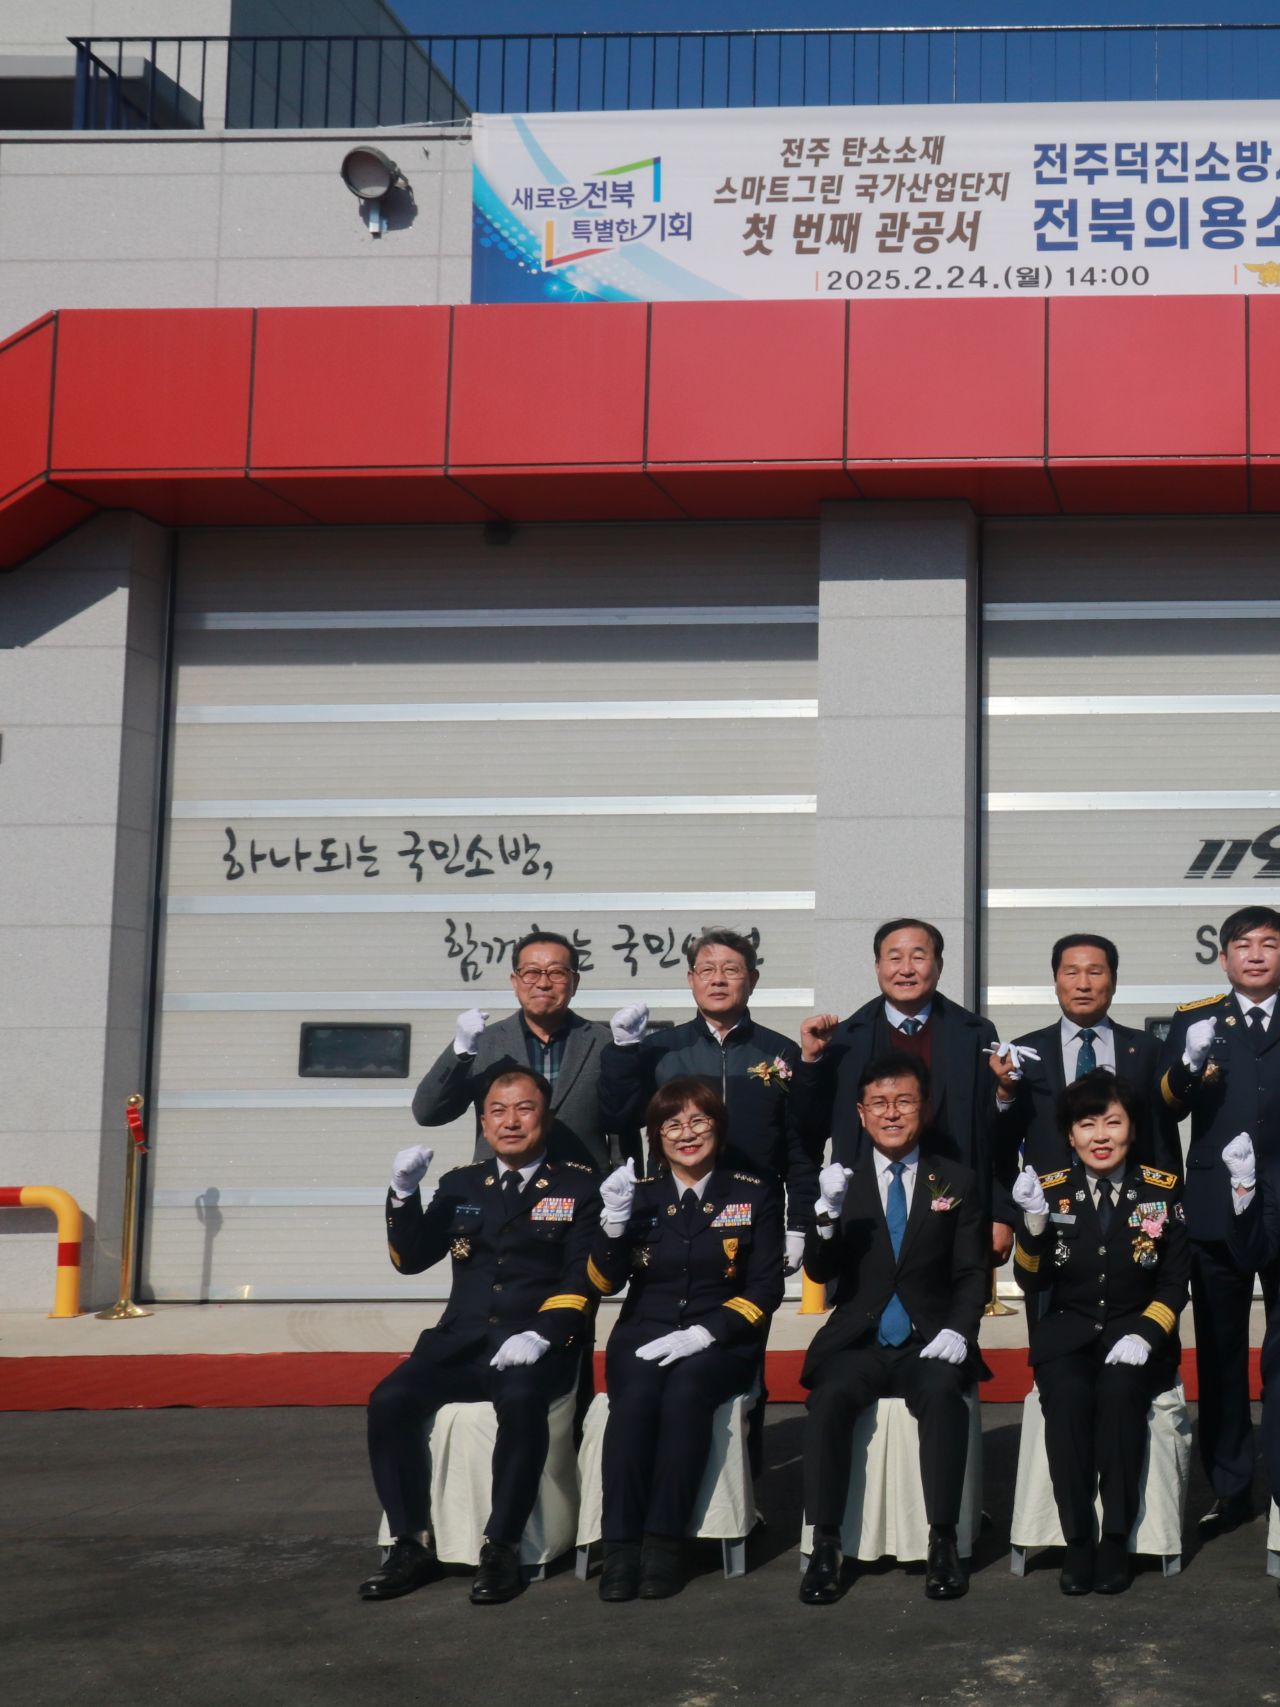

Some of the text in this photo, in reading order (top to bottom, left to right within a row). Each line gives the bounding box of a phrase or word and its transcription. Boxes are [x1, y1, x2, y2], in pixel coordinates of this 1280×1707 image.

[779, 135, 945, 168] 전주 탄소소재
[713, 171, 1011, 204] 스마트그린 국가산업단지
[742, 210, 982, 256] 첫 번째 관공서
[826, 265, 1150, 291] 2025.2.24.(월) 14:00
[222, 827, 554, 882] 하나되는 국민소방,
[611, 923, 765, 977] 국민
